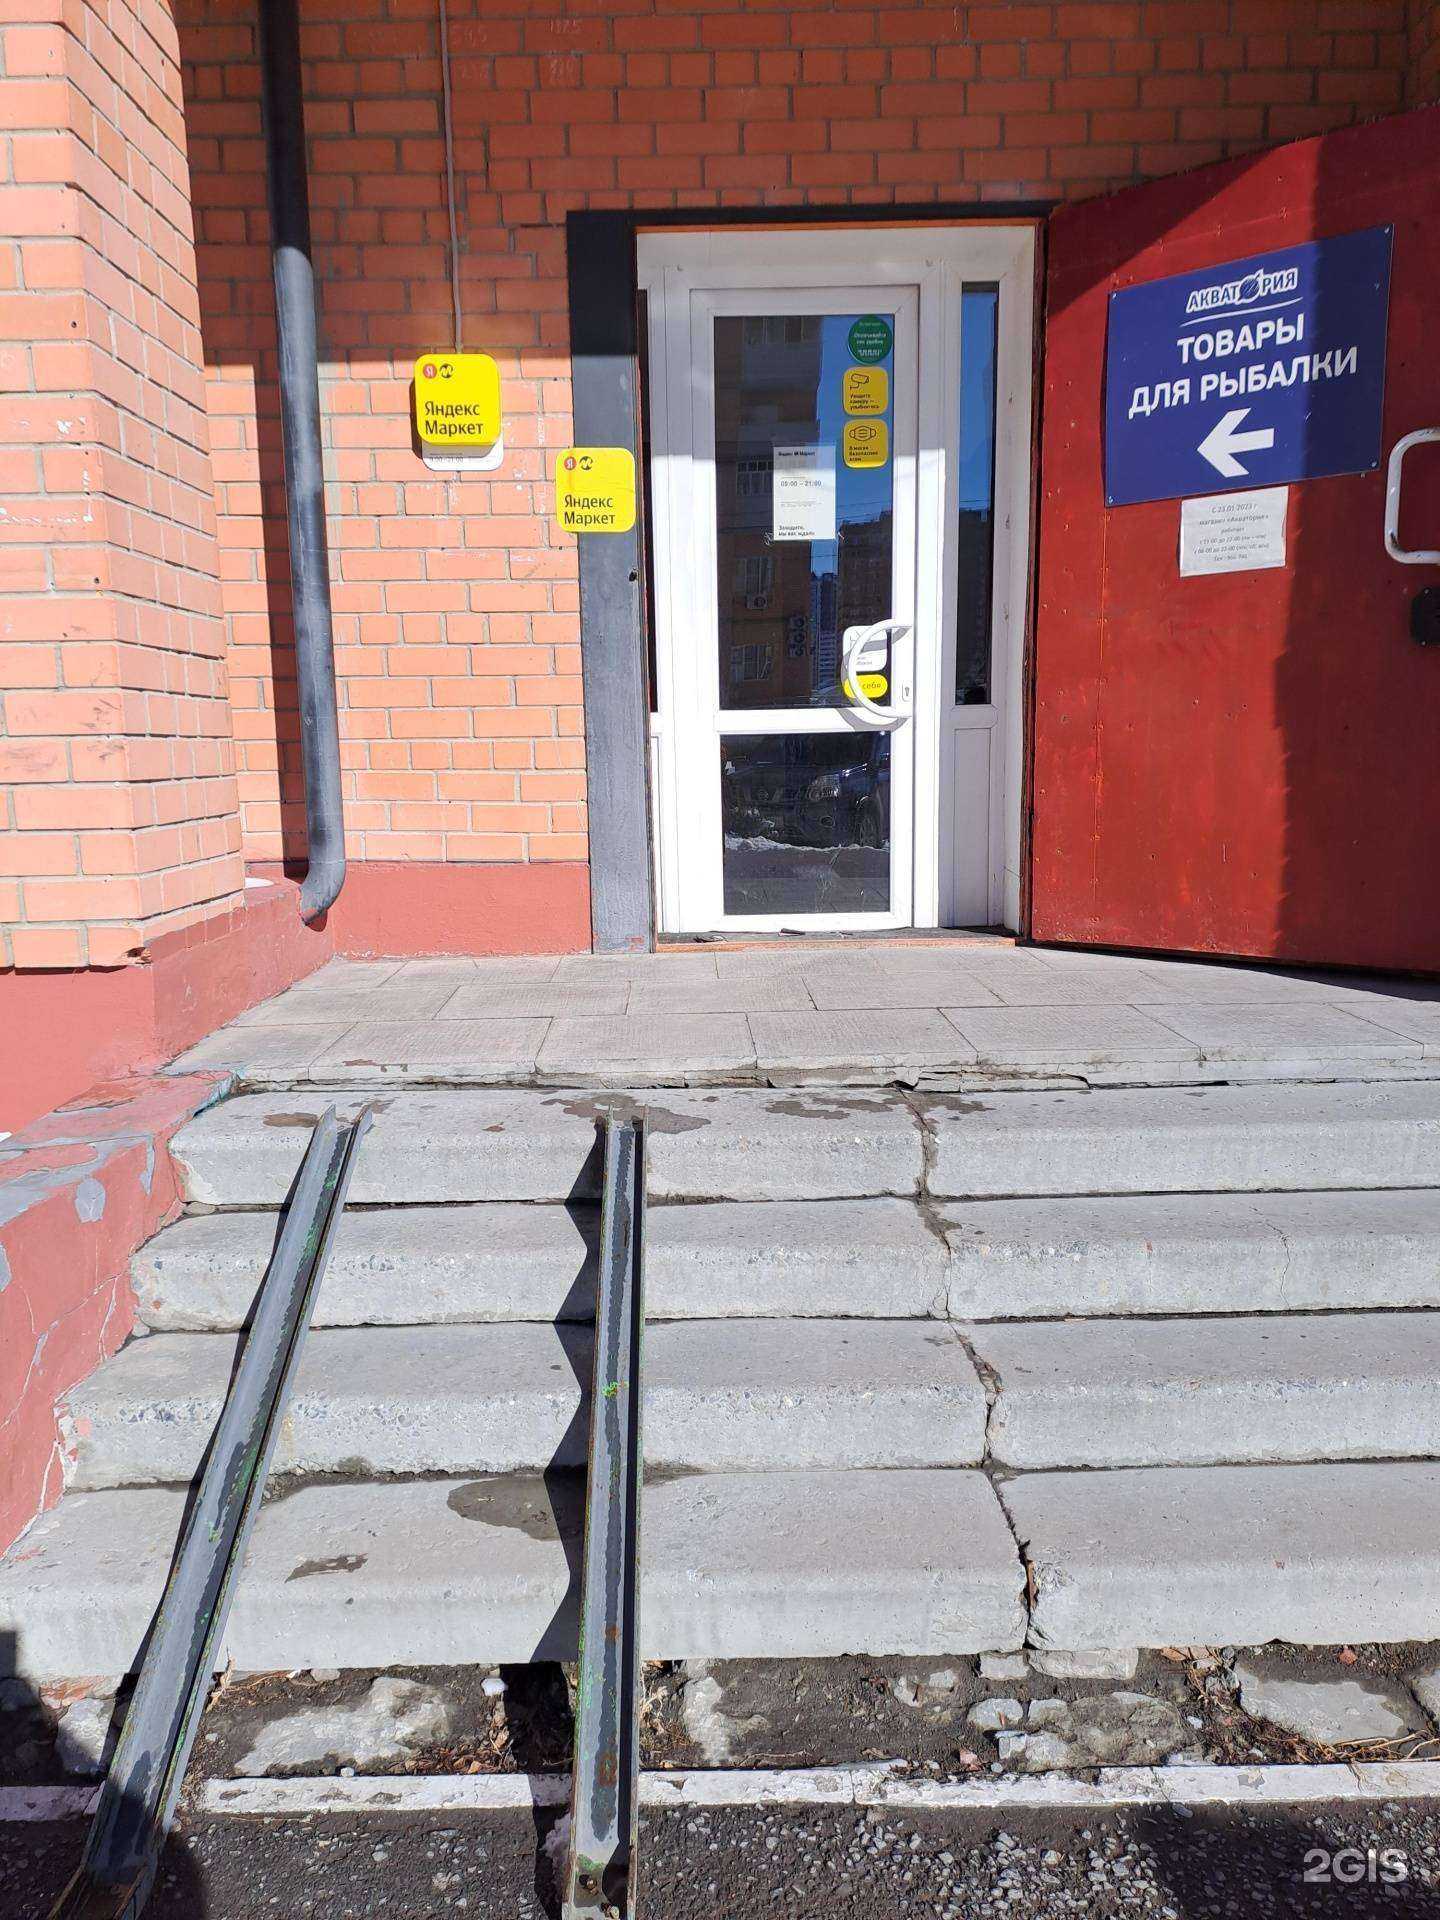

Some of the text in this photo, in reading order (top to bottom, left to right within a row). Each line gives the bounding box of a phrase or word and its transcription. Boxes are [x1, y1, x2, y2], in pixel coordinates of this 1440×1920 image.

[1177, 313, 1304, 364] ТОВАРЫ
[1128, 346, 1358, 420] ДЛЯ РЫБАЛКИ
[424, 401, 480, 416] Яндекс
[424, 420, 483, 437] Маркет
[564, 495, 613, 508] Яндекс
[564, 511, 615, 526] Маркет
